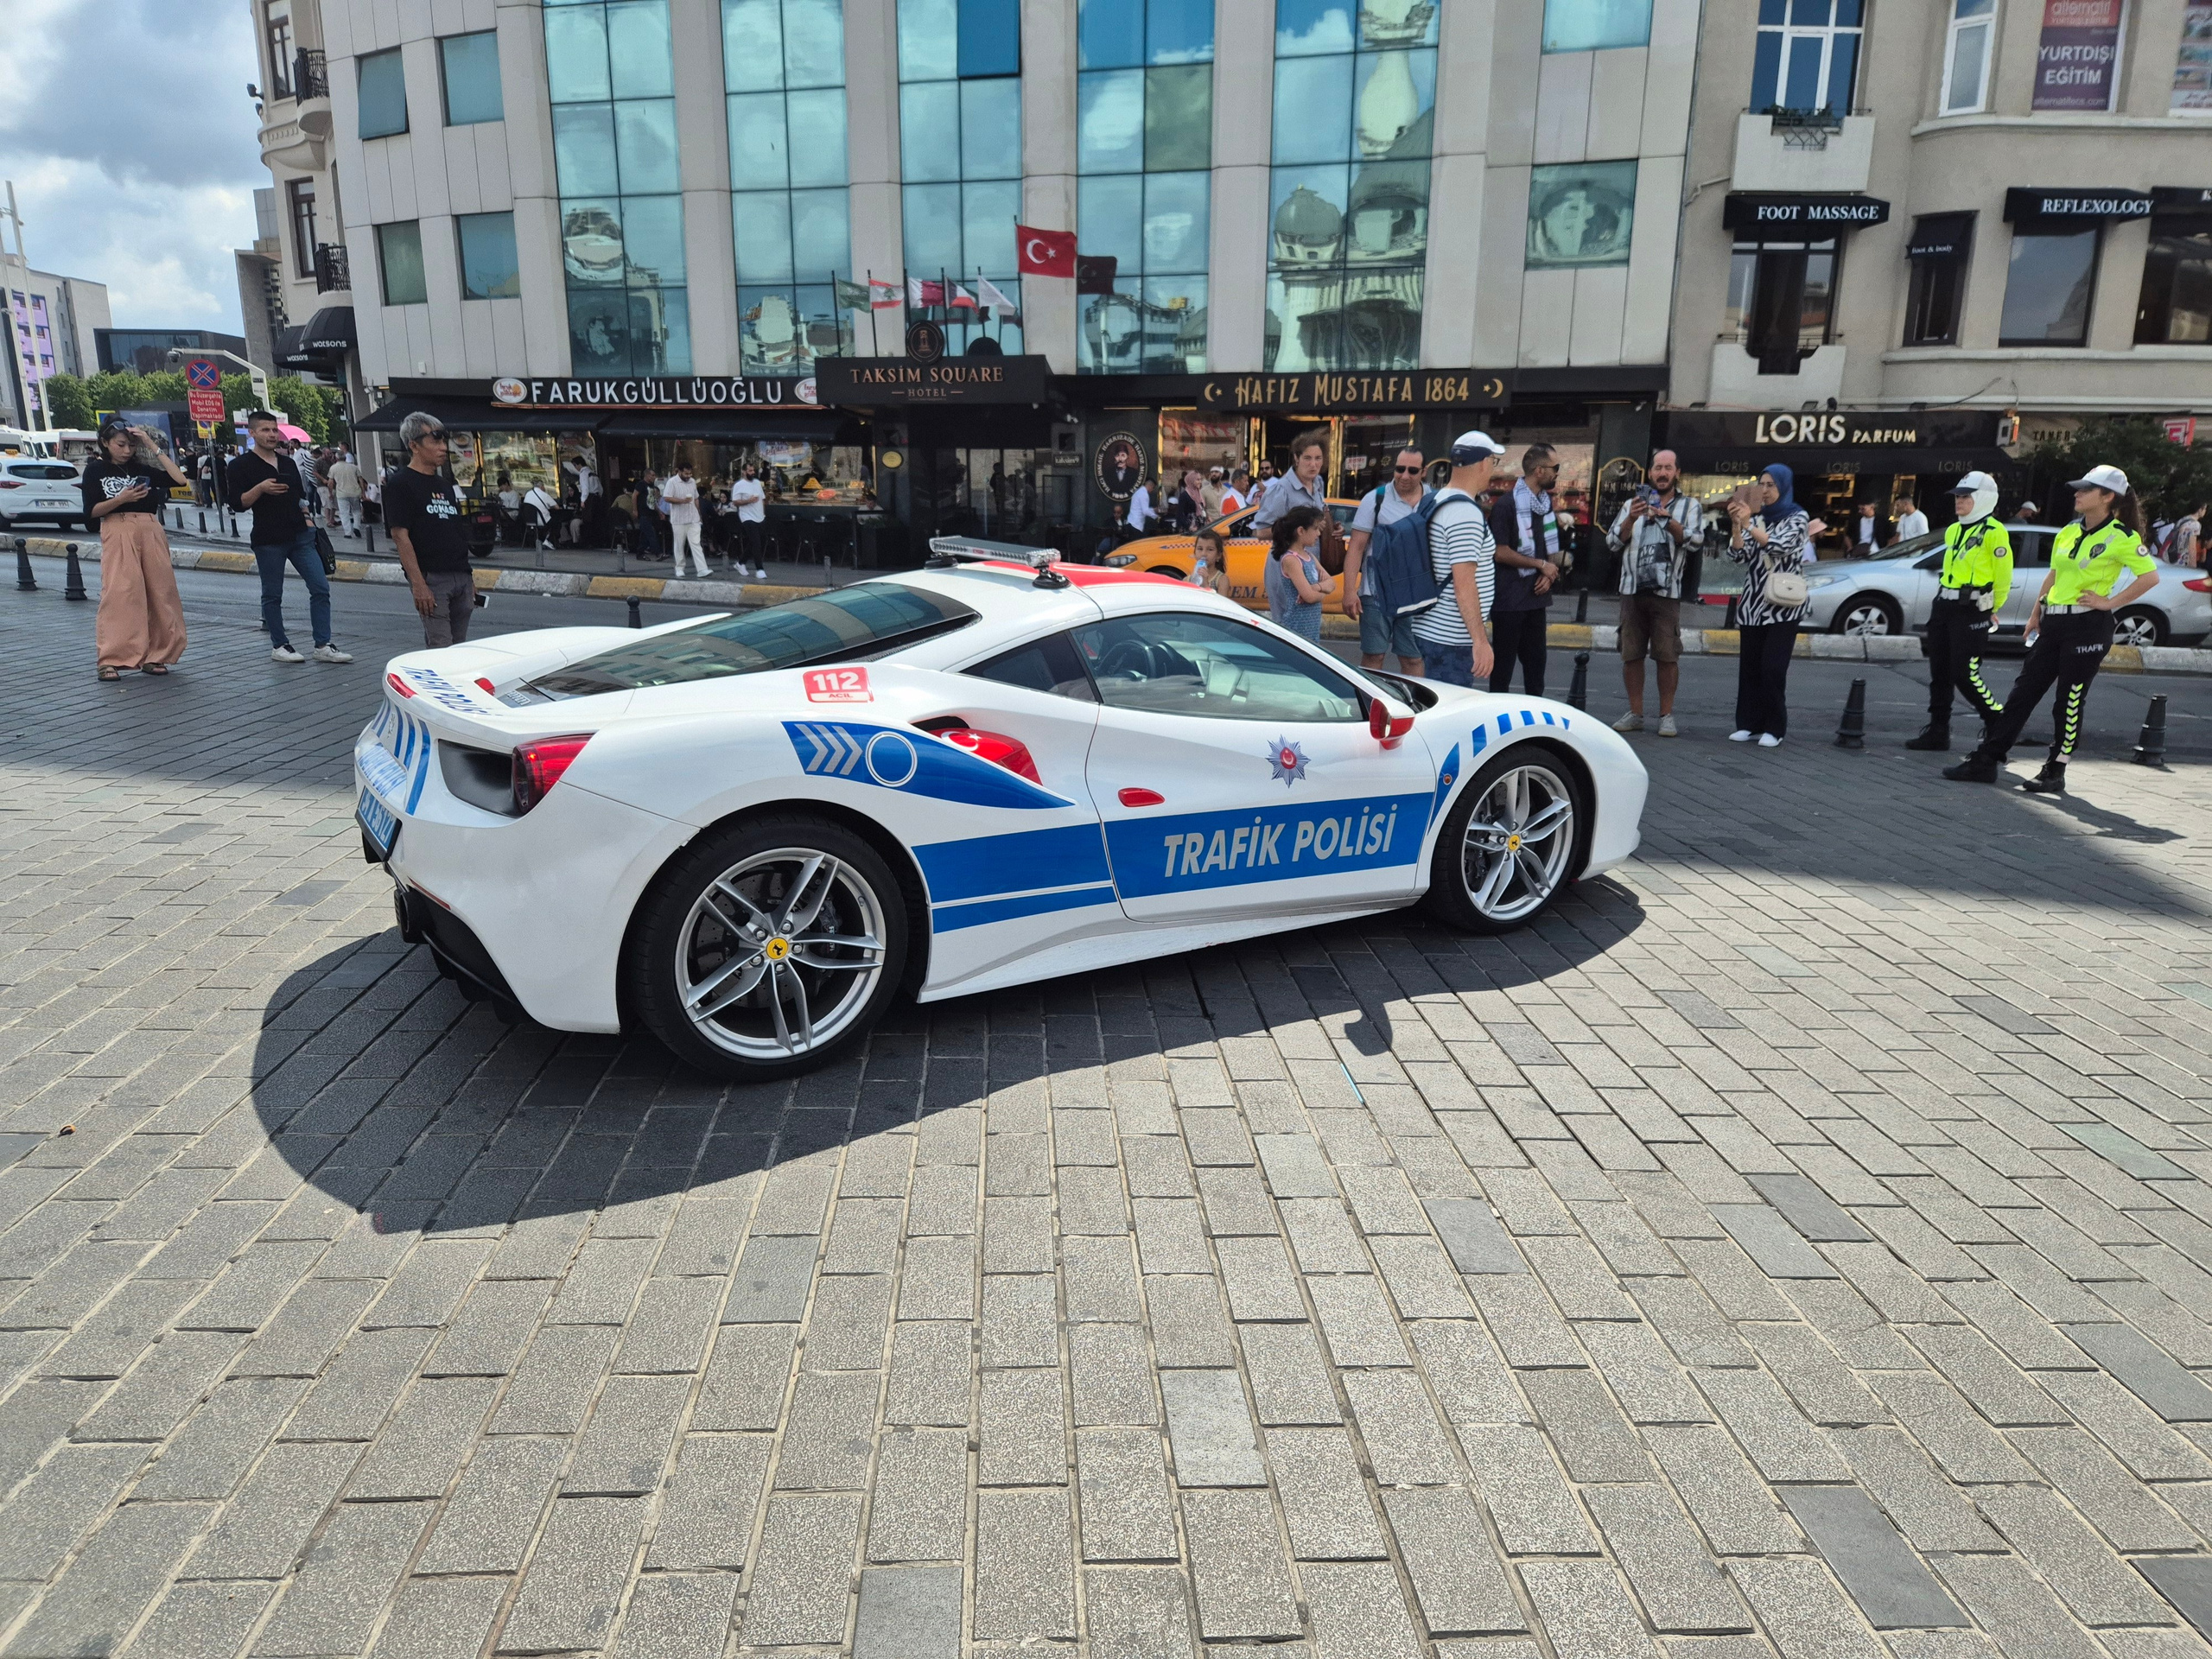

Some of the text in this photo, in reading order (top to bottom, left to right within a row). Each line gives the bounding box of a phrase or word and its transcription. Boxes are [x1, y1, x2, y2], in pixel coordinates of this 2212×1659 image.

[2044, 67, 2102, 85] EĞİTİM
[1758, 206, 1879, 219] FOOT MASSAGE
[2041, 198, 2154, 214] REFLEXOLOGY
[312, 340, 347, 348] watsons
[286, 353, 308, 362] watsons
[850, 365, 1004, 384] TAKSİM SQUARE
[908, 388, 947, 397] HOTEL
[1235, 373, 1469, 408] HAFIZ MUSTAFA 1864
[1755, 414, 1916, 444] LORIS PARFUM
[1714, 461, 1750, 473] LORIS
[1827, 462, 1860, 474] LORIS
[1938, 461, 1974, 473] LORIS
[812, 671, 862, 691] 112
[1164, 804, 1398, 878] TRAFİK POLİSİ
